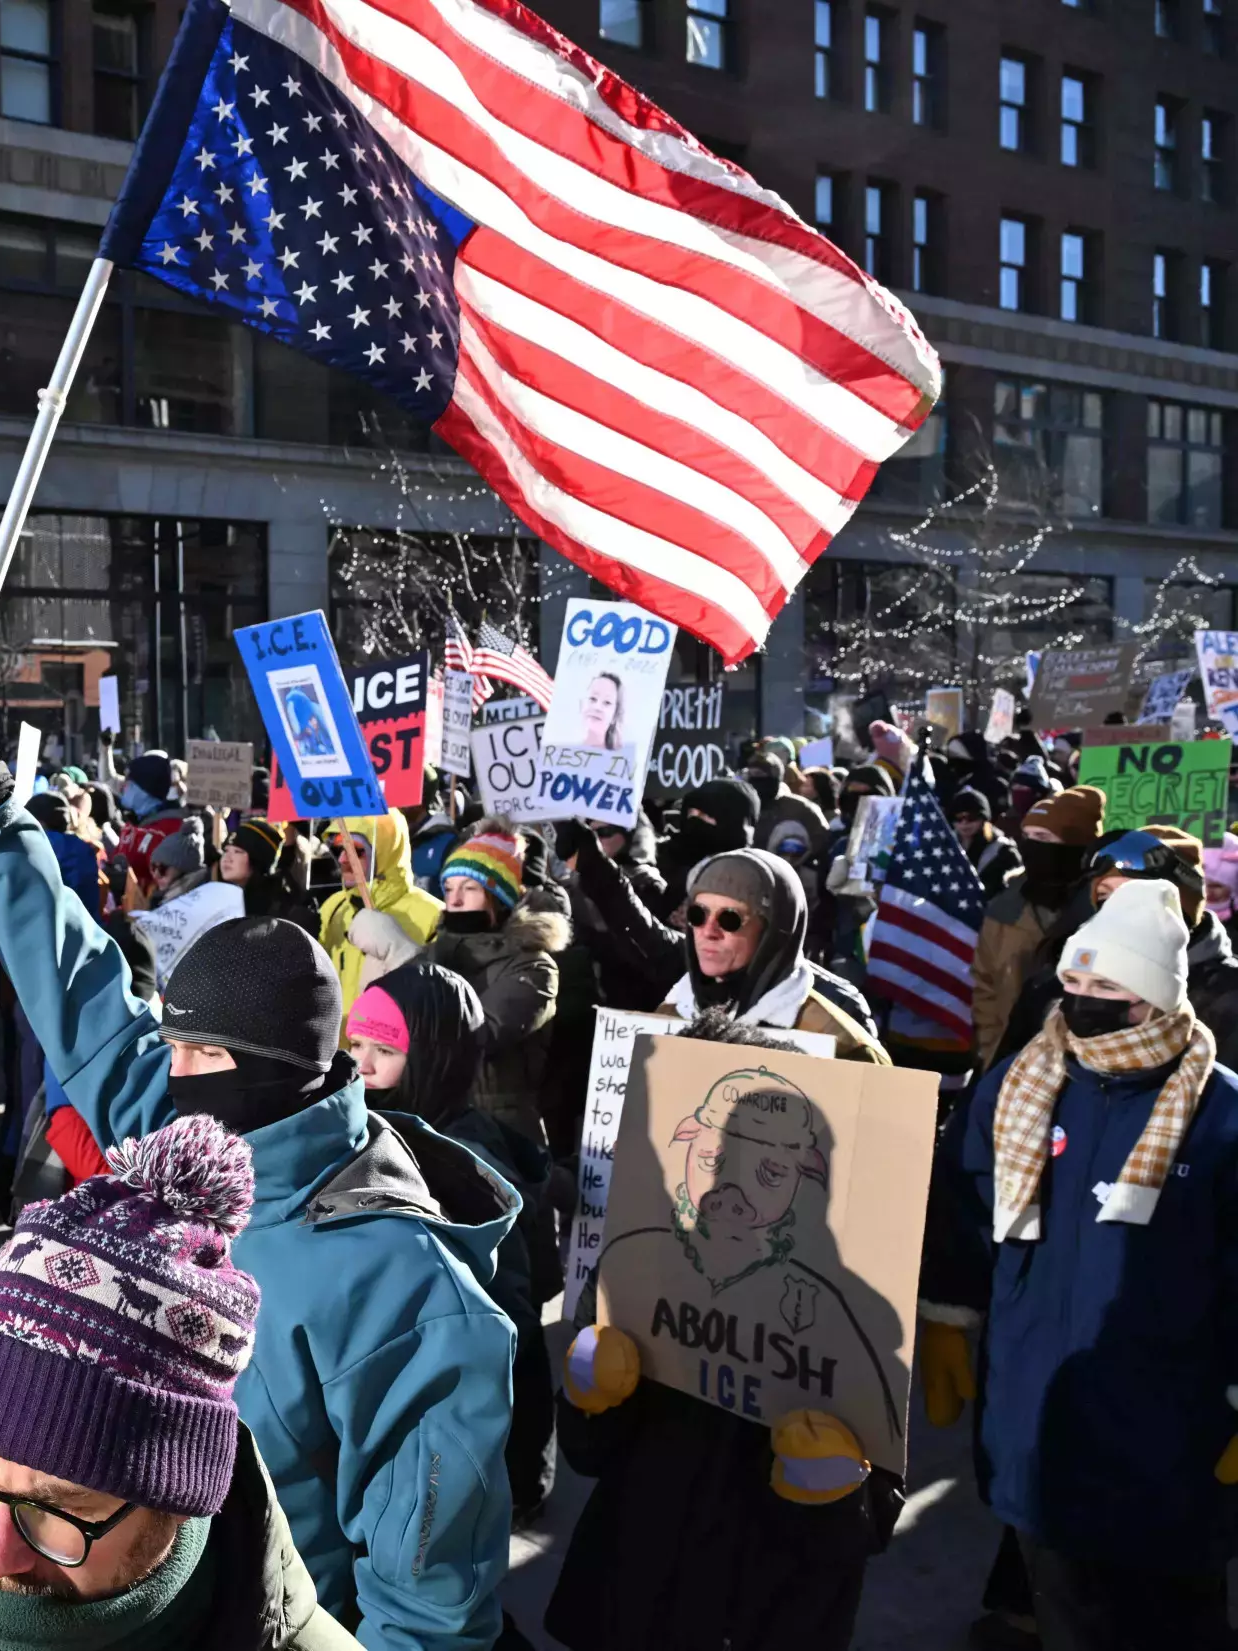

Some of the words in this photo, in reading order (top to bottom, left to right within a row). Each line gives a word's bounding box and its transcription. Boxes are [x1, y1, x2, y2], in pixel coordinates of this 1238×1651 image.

[566, 610, 671, 654] GOOD
[353, 664, 421, 713] ICE
[542, 745, 603, 768] REST
[604, 756, 638, 782] IN
[658, 742, 724, 788] GOOD
[1117, 744, 1183, 775] NO
[488, 759, 537, 793] OU
[300, 778, 376, 809] OUT!
[538, 770, 634, 815] POWER
[600, 1054, 629, 1069] wa
[591, 1097, 613, 1125] to
[582, 1164, 605, 1190] He
[581, 1194, 607, 1218] bu
[577, 1222, 601, 1249] He
[575, 1256, 591, 1279] in
[650, 1297, 838, 1399] ABOLISH
